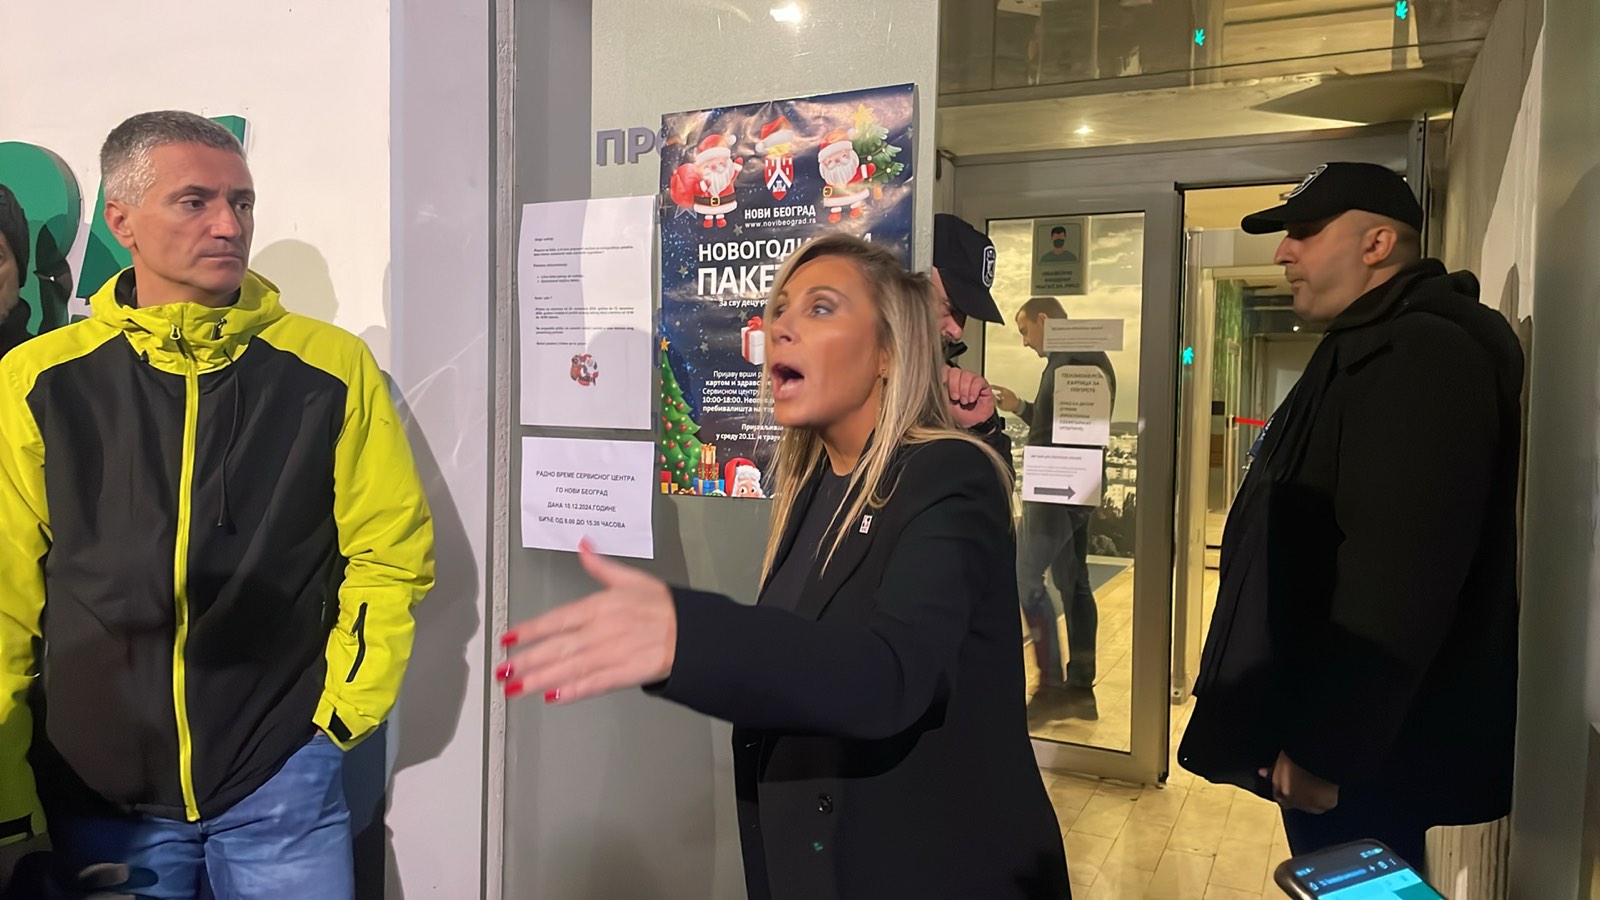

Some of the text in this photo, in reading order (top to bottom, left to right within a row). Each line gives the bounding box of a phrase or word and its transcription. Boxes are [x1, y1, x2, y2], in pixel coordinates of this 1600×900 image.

[596, 128, 663, 166] ПР
[745, 204, 817, 220] НОВИ БЕОГРАД
[745, 217, 817, 228] www.novibeograd.rs
[697, 264, 784, 296] ПАКЕ
[718, 299, 728, 307] За
[728, 299, 741, 308] сву
[741, 299, 759, 308] децу
[713, 371, 738, 380] Пријаву
[739, 371, 757, 379] врши
[705, 380, 731, 388] картом
[702, 388, 737, 396] Сервисном
[702, 396, 743, 404] 10:00-18:00.
[702, 404, 752, 414] пребивалишта
[715, 433, 721, 441] у
[720, 433, 739, 441] среду
[536, 470, 635, 482] РАДНО ВРЕМЕ СЕРВИСНОГ ЦЕНТРА
[581, 488, 608, 497] БЕОГРАД
[547, 501, 563, 509] ДАНА
[538, 515, 554, 523] БИЋЕ
[555, 516, 564, 524] ОД
[576, 518, 585, 526] ДО
[600, 520, 626, 529] ЧАСОВА
